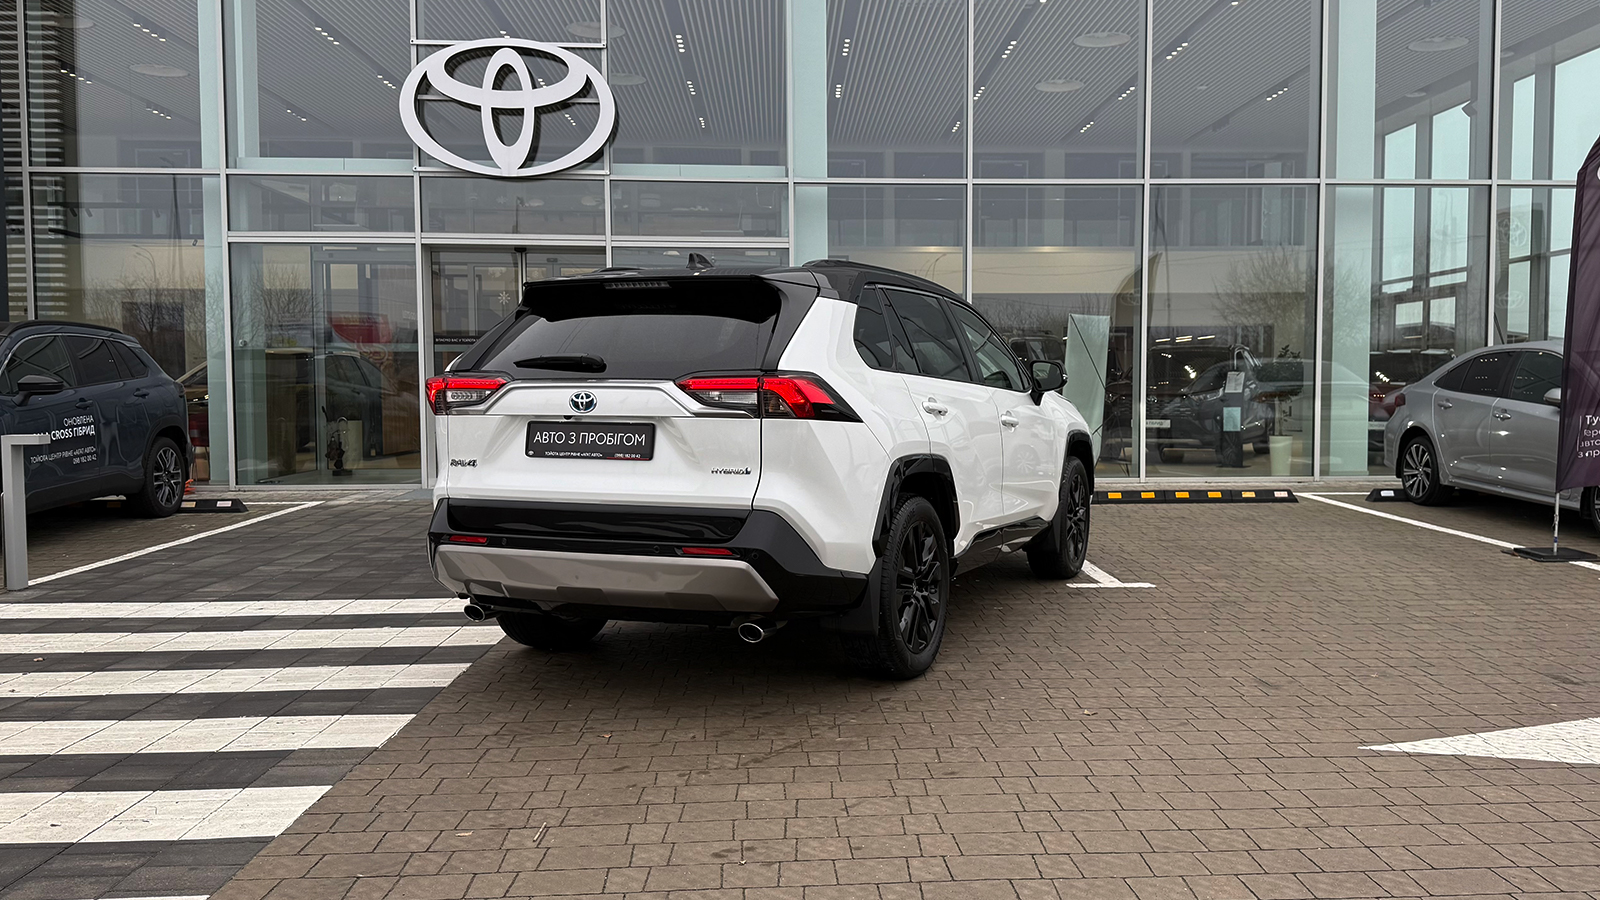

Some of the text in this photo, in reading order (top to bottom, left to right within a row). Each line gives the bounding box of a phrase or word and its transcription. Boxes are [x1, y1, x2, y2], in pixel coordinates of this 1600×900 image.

[63, 415, 94, 427] ОНОВЛЕНА
[1585, 414, 1600, 426] Ту
[51, 424, 96, 440] CROSS ГІБРИД
[533, 431, 566, 444] АВТО
[579, 432, 646, 446] ПРОБІГОМ
[30, 454, 48, 464] ТОЙОТА
[48, 451, 61, 461] ЦЕНТР
[62, 449, 73, 458] РІВНЕ
[450, 459, 478, 467] RAV4
[711, 467, 745, 475] HYBRID
